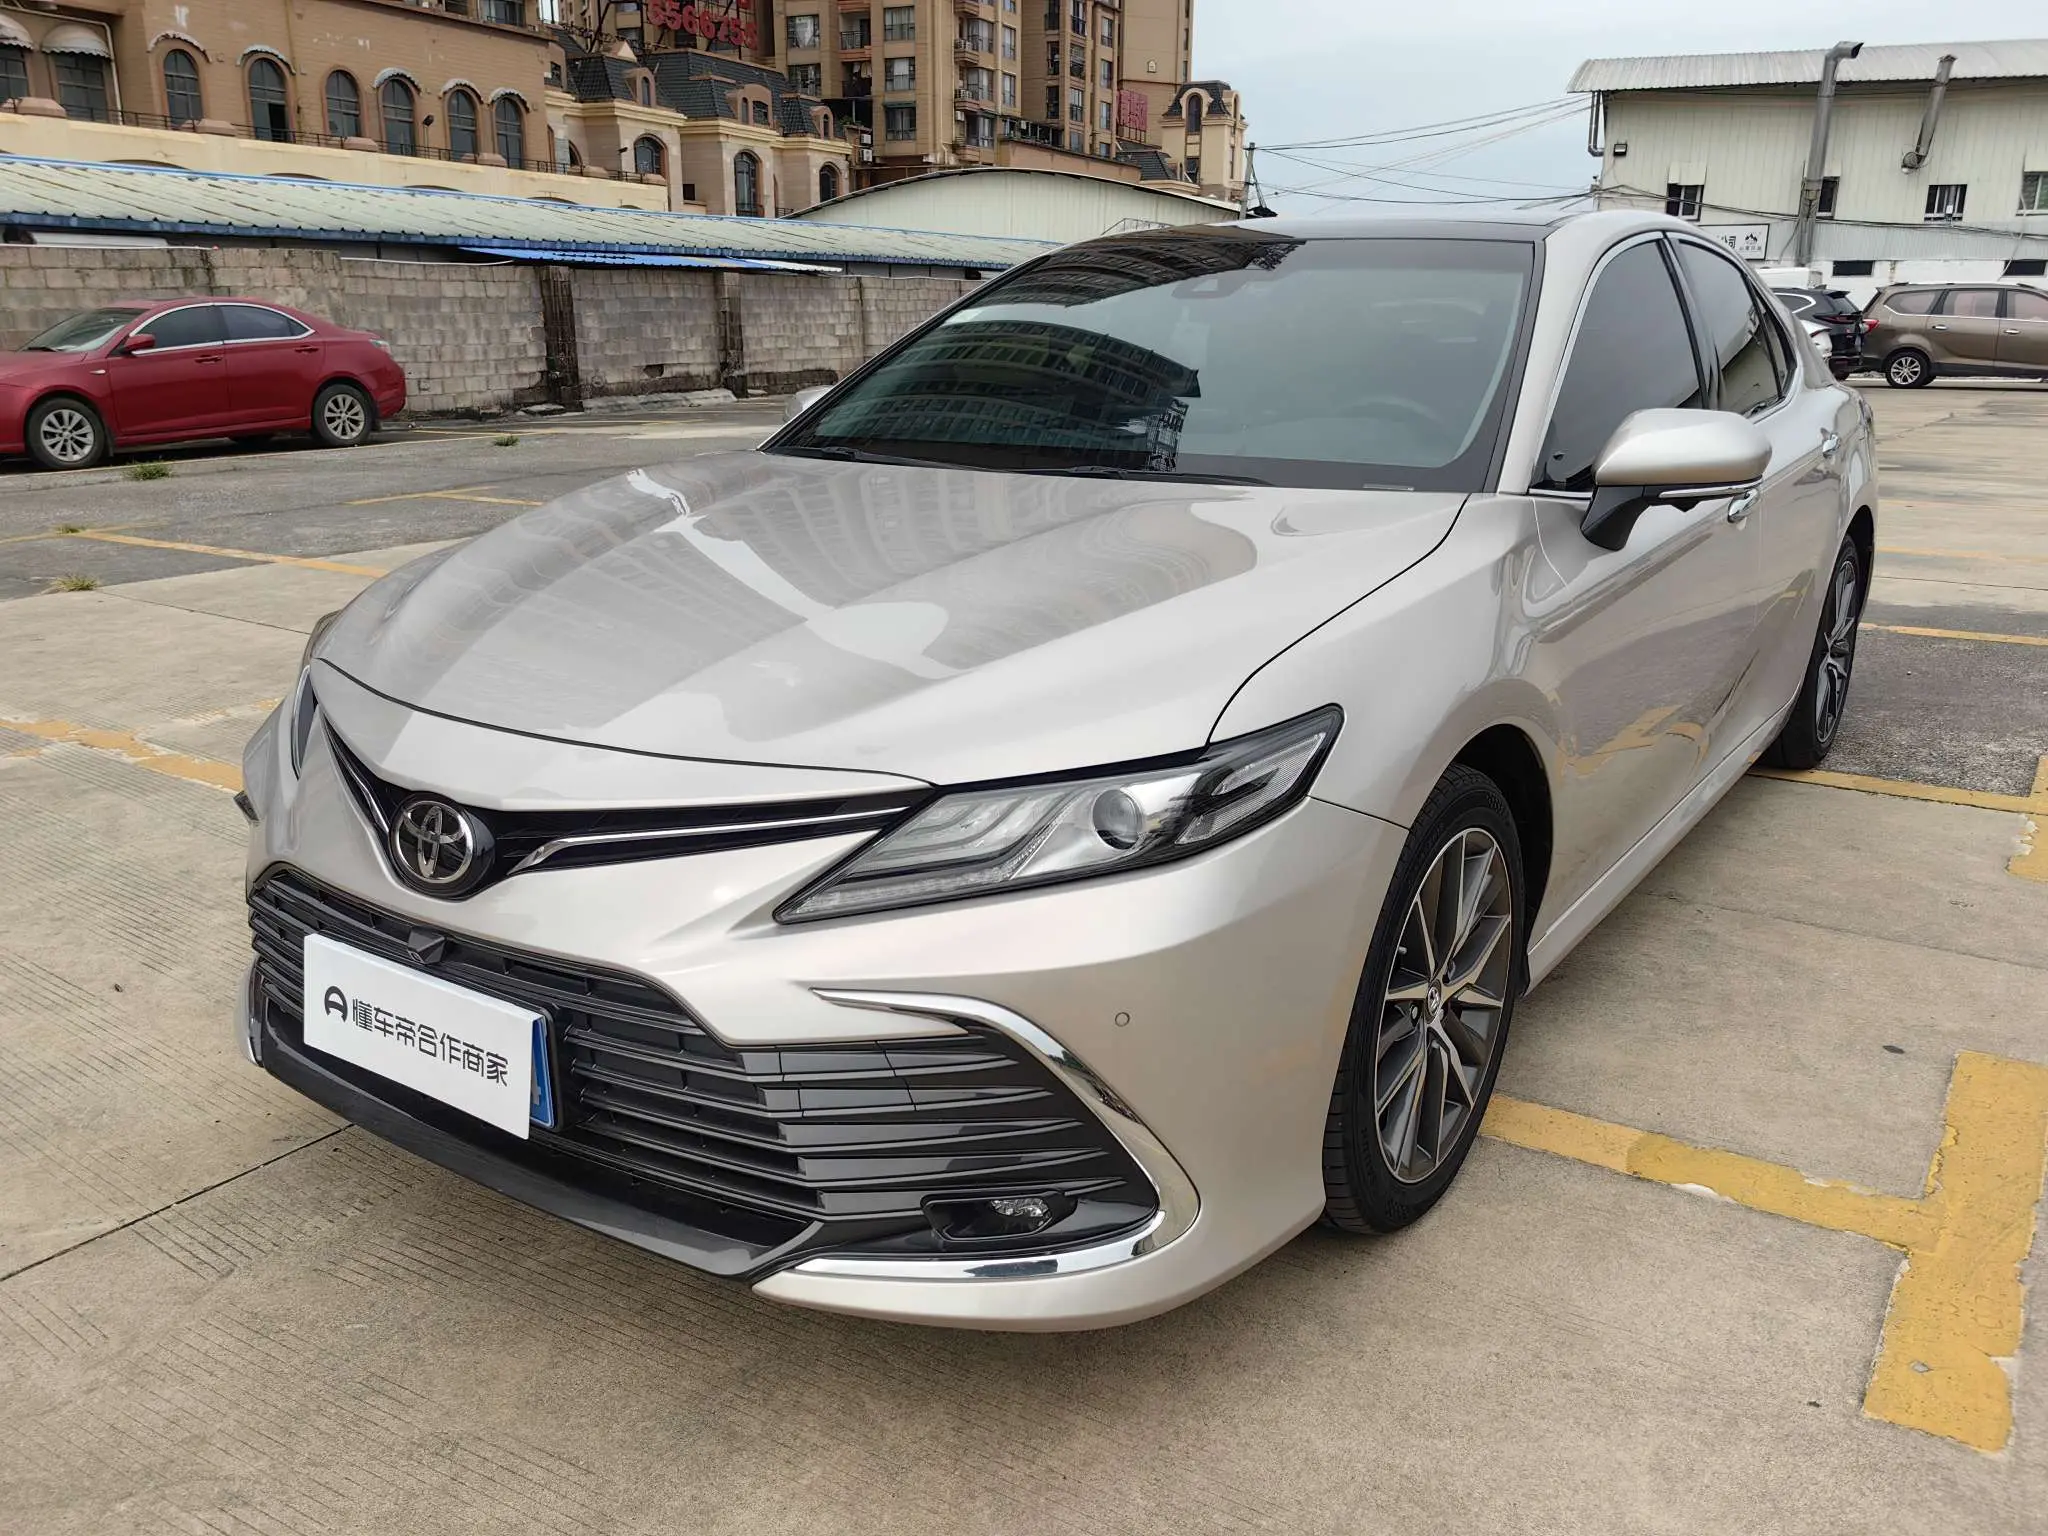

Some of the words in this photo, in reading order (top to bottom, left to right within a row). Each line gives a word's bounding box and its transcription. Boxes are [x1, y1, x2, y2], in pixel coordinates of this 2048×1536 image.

[352, 998, 509, 1087] 懂车帝合作商家
